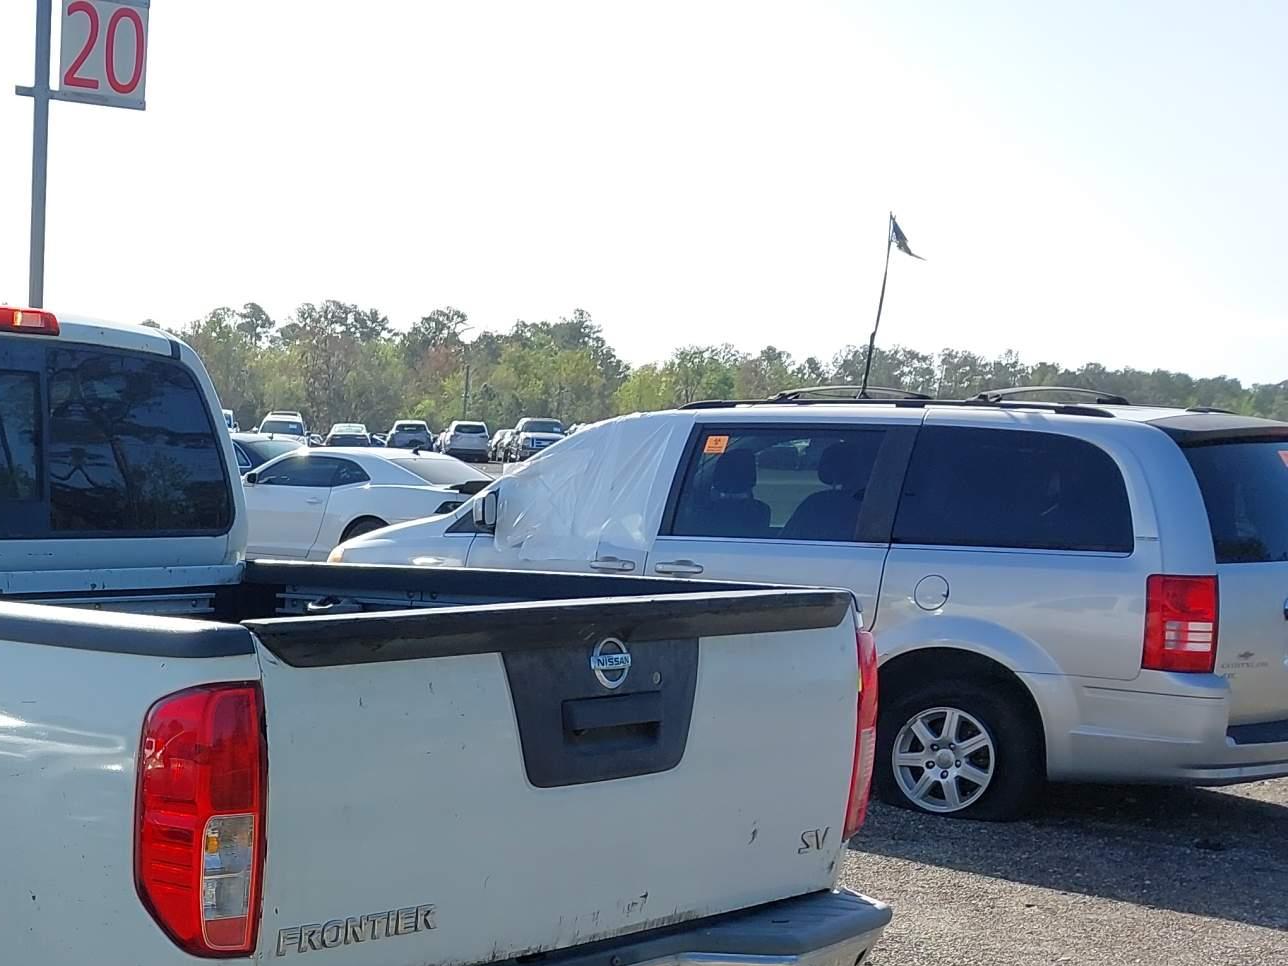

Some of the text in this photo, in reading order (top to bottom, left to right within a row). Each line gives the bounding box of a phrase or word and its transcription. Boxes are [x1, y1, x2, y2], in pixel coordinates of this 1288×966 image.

[63, 1, 145, 95] 20
[597, 656, 630, 667] NISSAN
[797, 826, 830, 855] SV
[275, 903, 439, 957] FRONTIER
